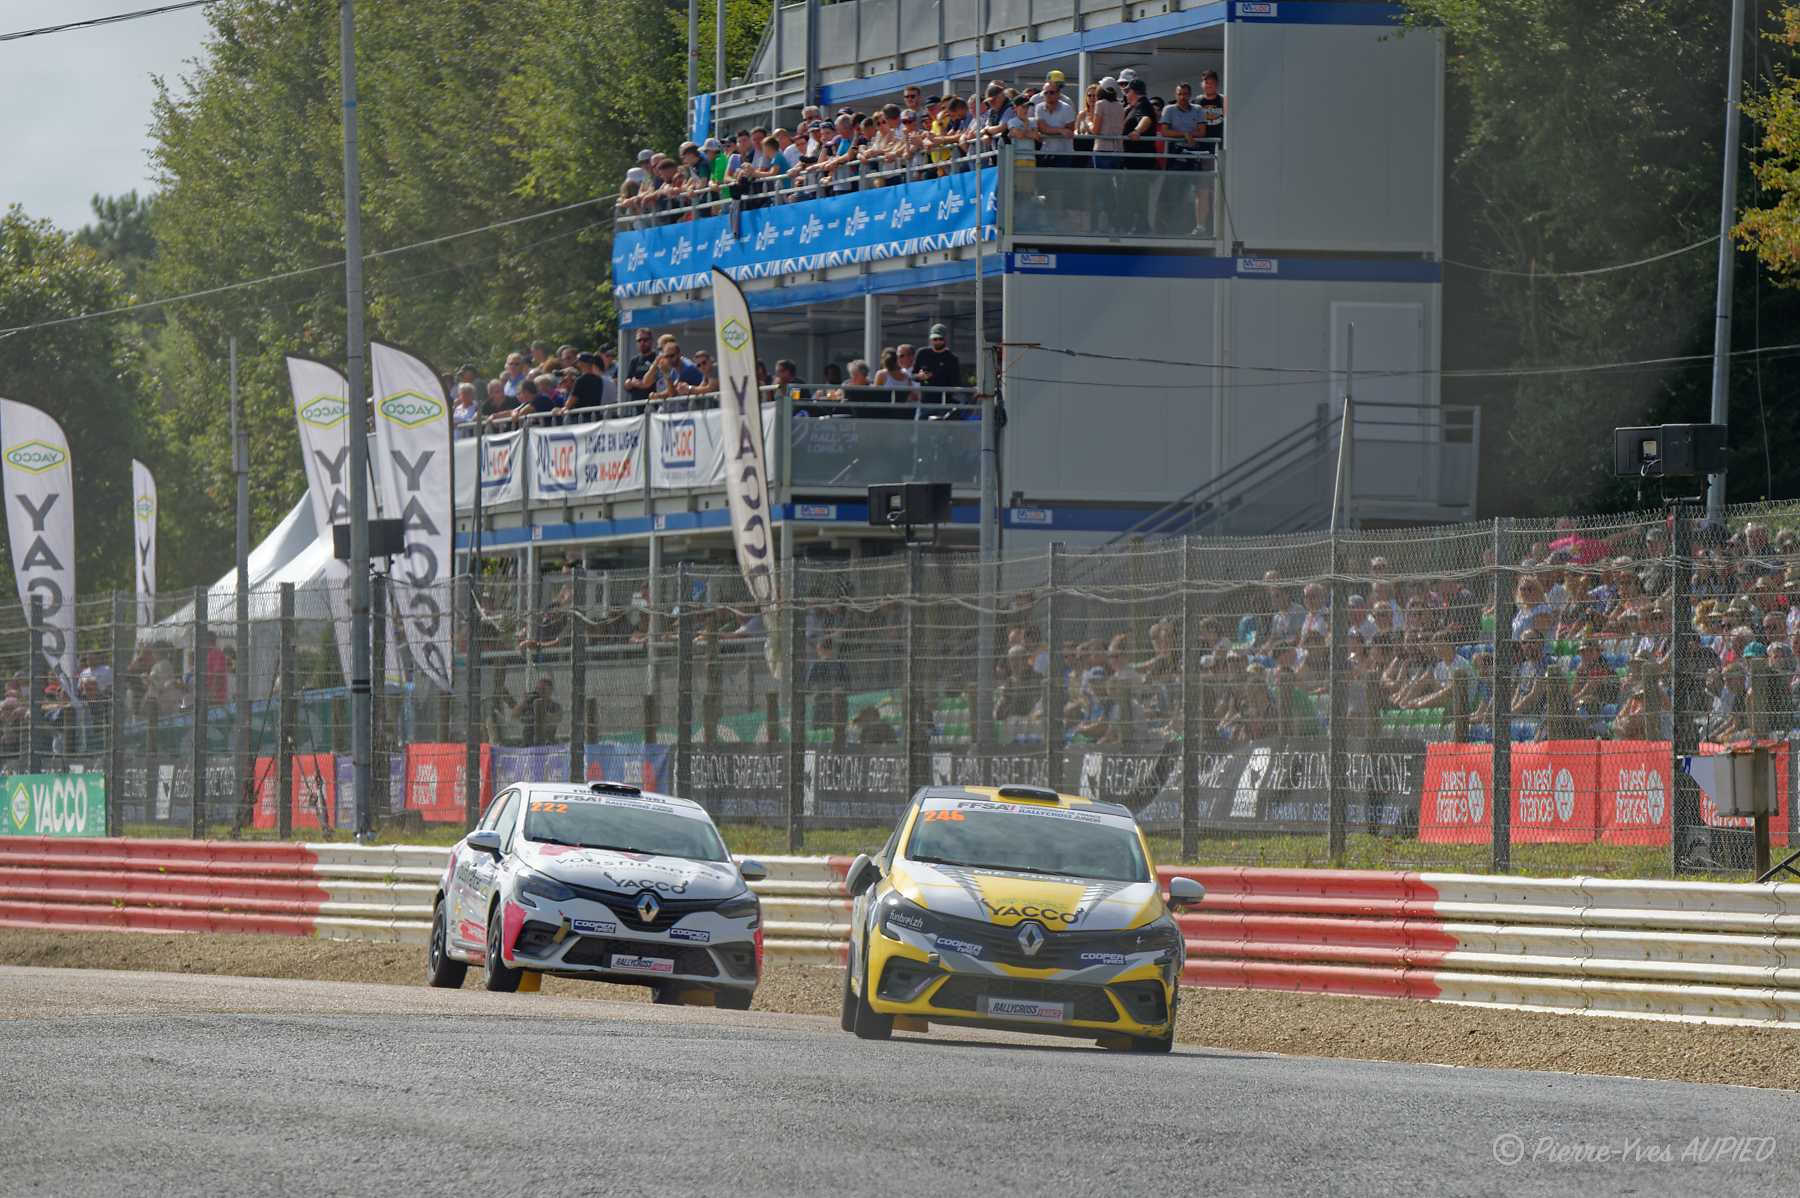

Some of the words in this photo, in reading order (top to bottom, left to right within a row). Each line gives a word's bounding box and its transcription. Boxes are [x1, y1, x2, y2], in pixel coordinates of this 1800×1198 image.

[32, 778, 87, 832] YACCO
[530, 802, 569, 814] 222
[603, 872, 689, 895] YACCO
[981, 898, 1084, 924] YACCO
[574, 920, 616, 930] COOPER
[670, 929, 709, 938] COOPER
[936, 937, 983, 952] COOPER
[1080, 952, 1126, 961] COOPER
